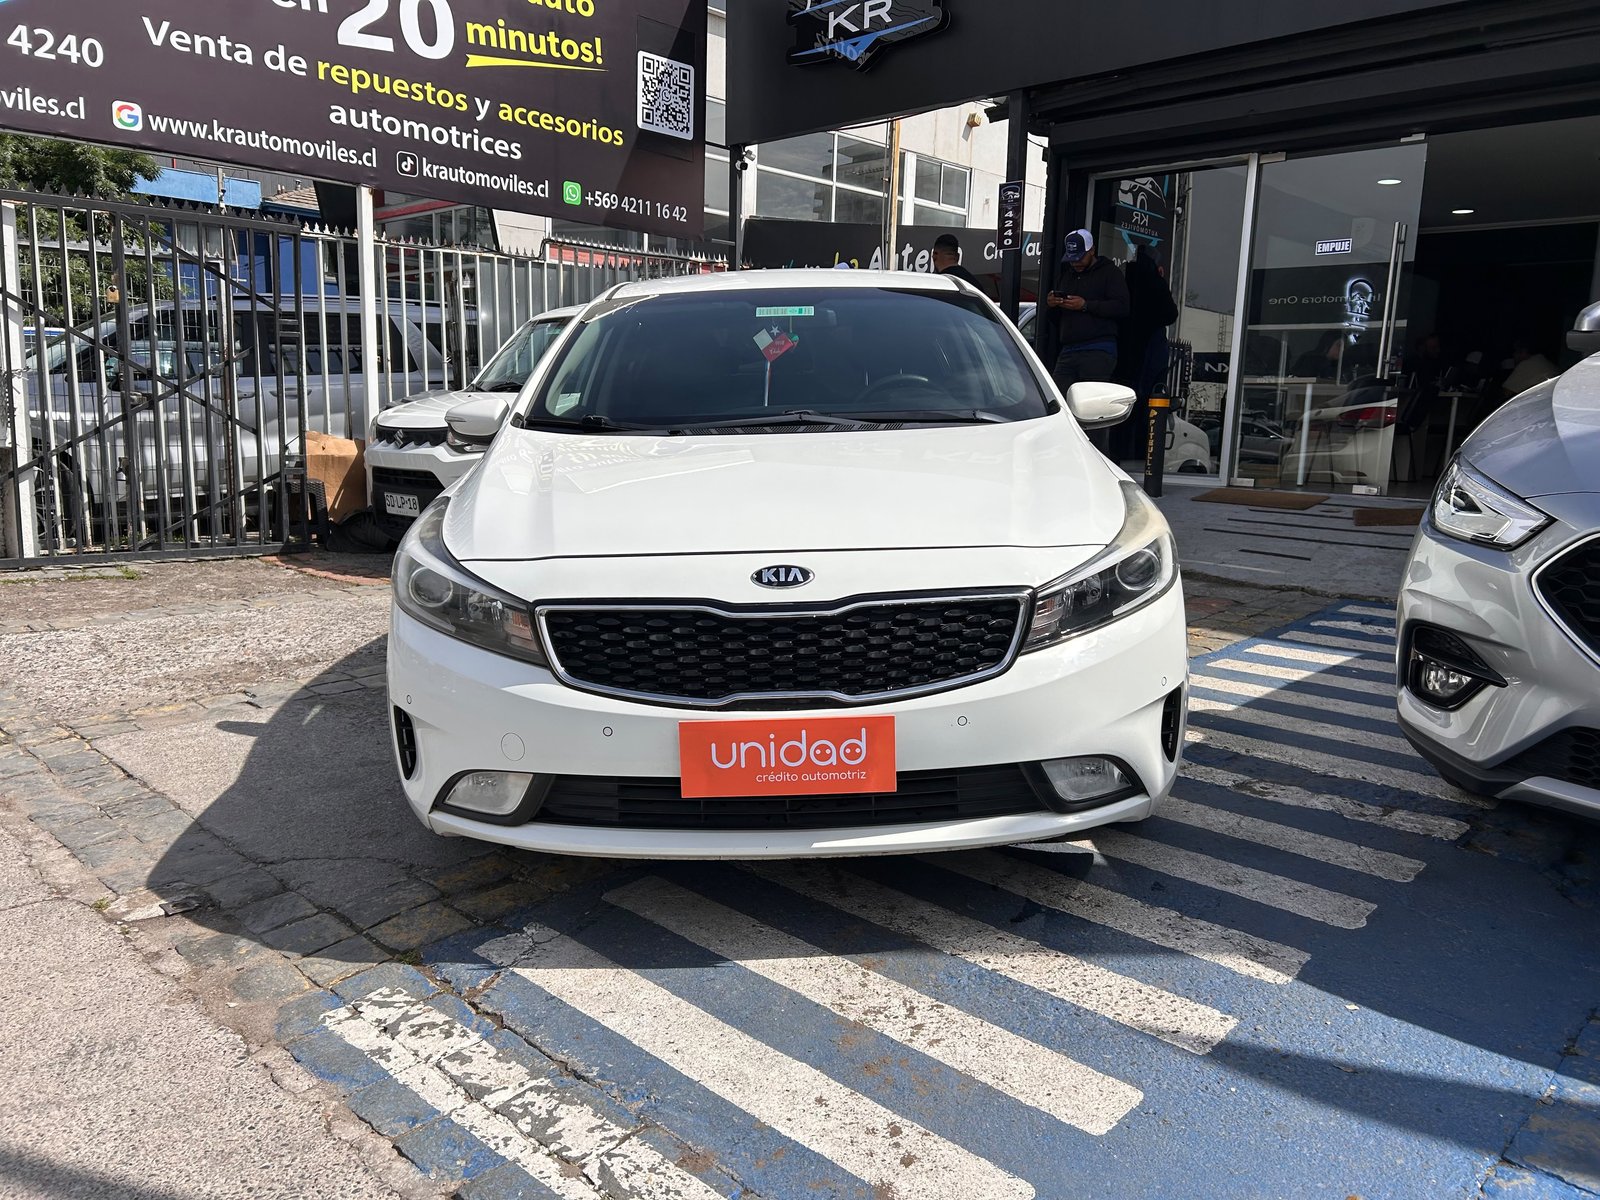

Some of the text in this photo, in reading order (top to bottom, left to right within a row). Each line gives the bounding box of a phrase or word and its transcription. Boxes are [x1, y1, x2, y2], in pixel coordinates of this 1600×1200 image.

[528, 0, 595, 17] uto
[828, 0, 893, 40] KR
[7, 24, 104, 68] 4240
[337, 0, 603, 65] 20 minutos!
[142, 15, 624, 146] Venta de repuestos y accesorios
[0, 86, 86, 120] viles.cl
[148, 114, 378, 168] www.krautomoviles.cl
[329, 103, 522, 161] automotrices
[422, 156, 549, 198] krautomoviles.cl
[585, 190, 687, 222] +569 4211 16 42
[1317, 241, 1350, 253] EMPUJE
[762, 567, 804, 583] KIA
[711, 727, 867, 769] unidad
[756, 769, 867, 783] crédito automotriz
